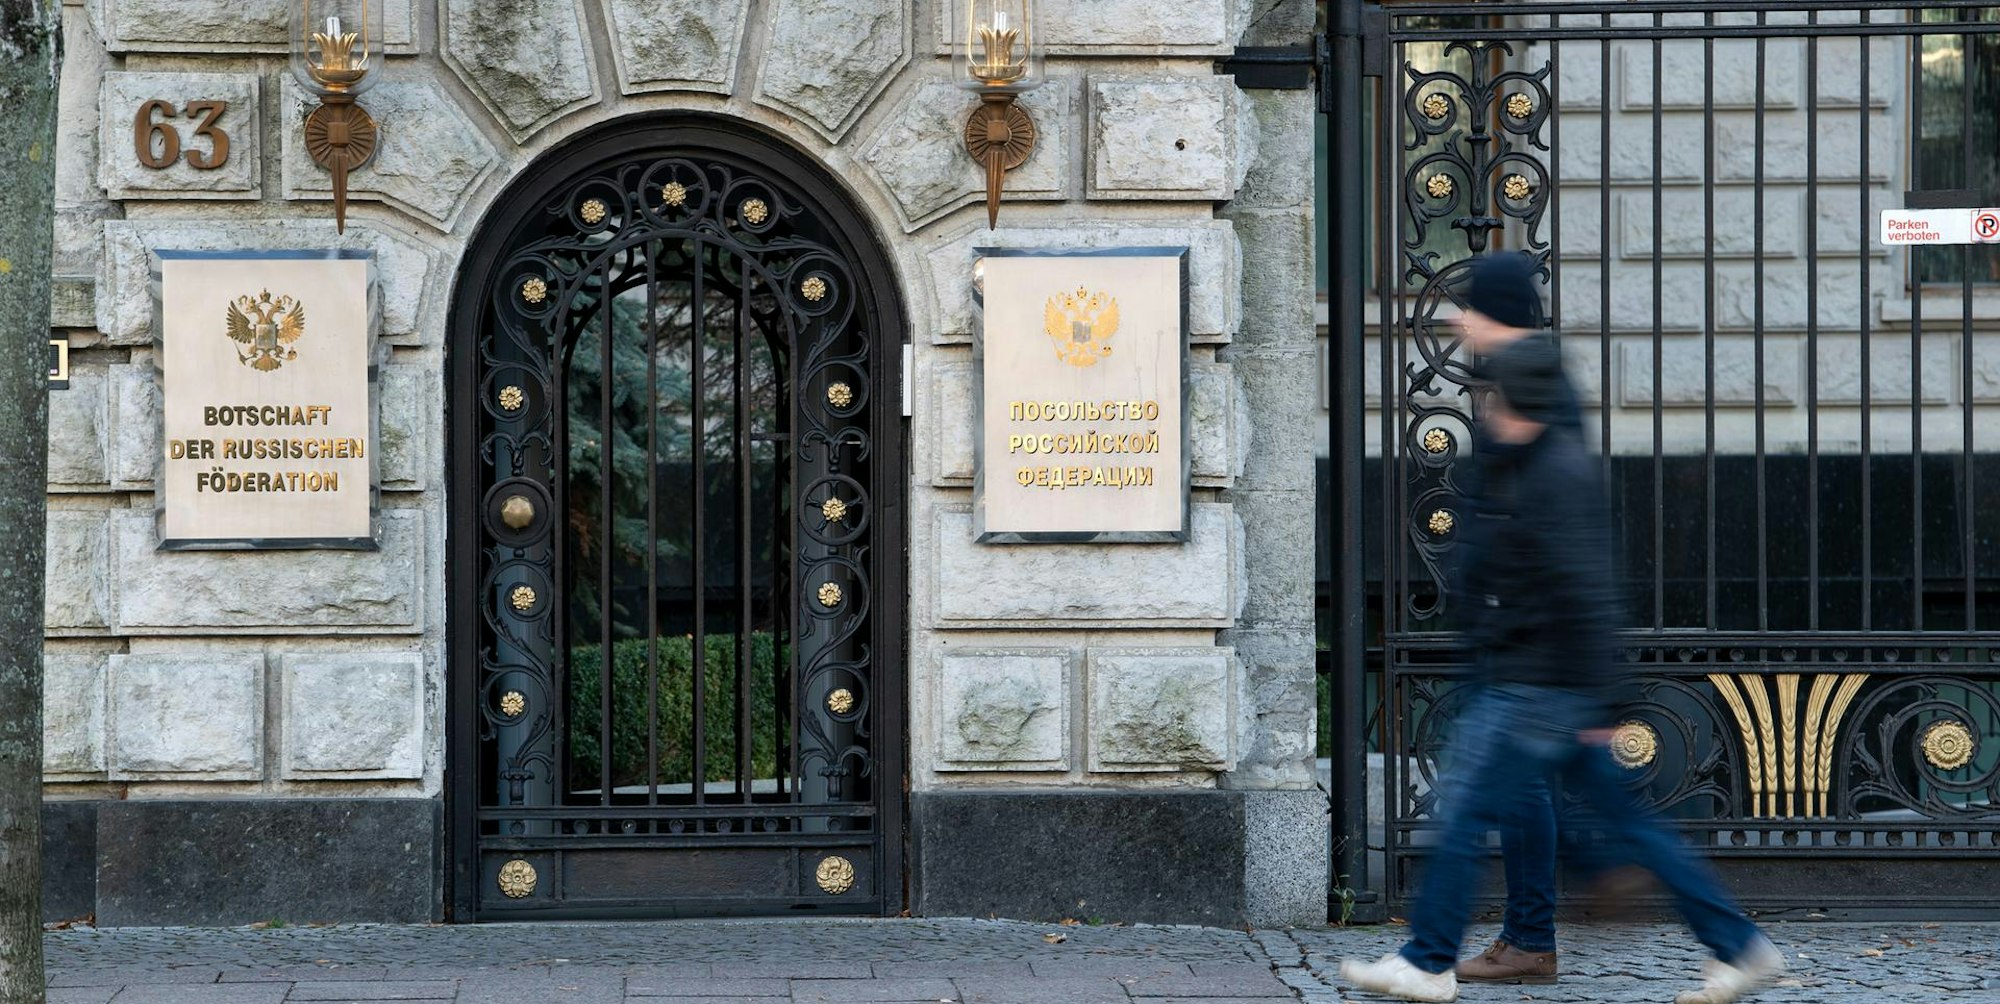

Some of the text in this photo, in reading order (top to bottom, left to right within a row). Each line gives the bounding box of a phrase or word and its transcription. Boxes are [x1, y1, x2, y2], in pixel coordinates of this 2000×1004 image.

[135, 101, 229, 169] 63
[1888, 219, 1929, 230] Parken
[1888, 231, 1940, 241] verboten
[204, 405, 332, 426] BOTSCHAFT
[1009, 401, 1159, 421] ПОСОЛЬСТВО
[170, 437, 364, 459] DER RUSSISCHEN
[1009, 429, 1159, 454] РОССИЙСКОЙ
[197, 466, 339, 492] FÖDERATION
[1016, 465, 1153, 490] ФЕДЕРАЦИИ
